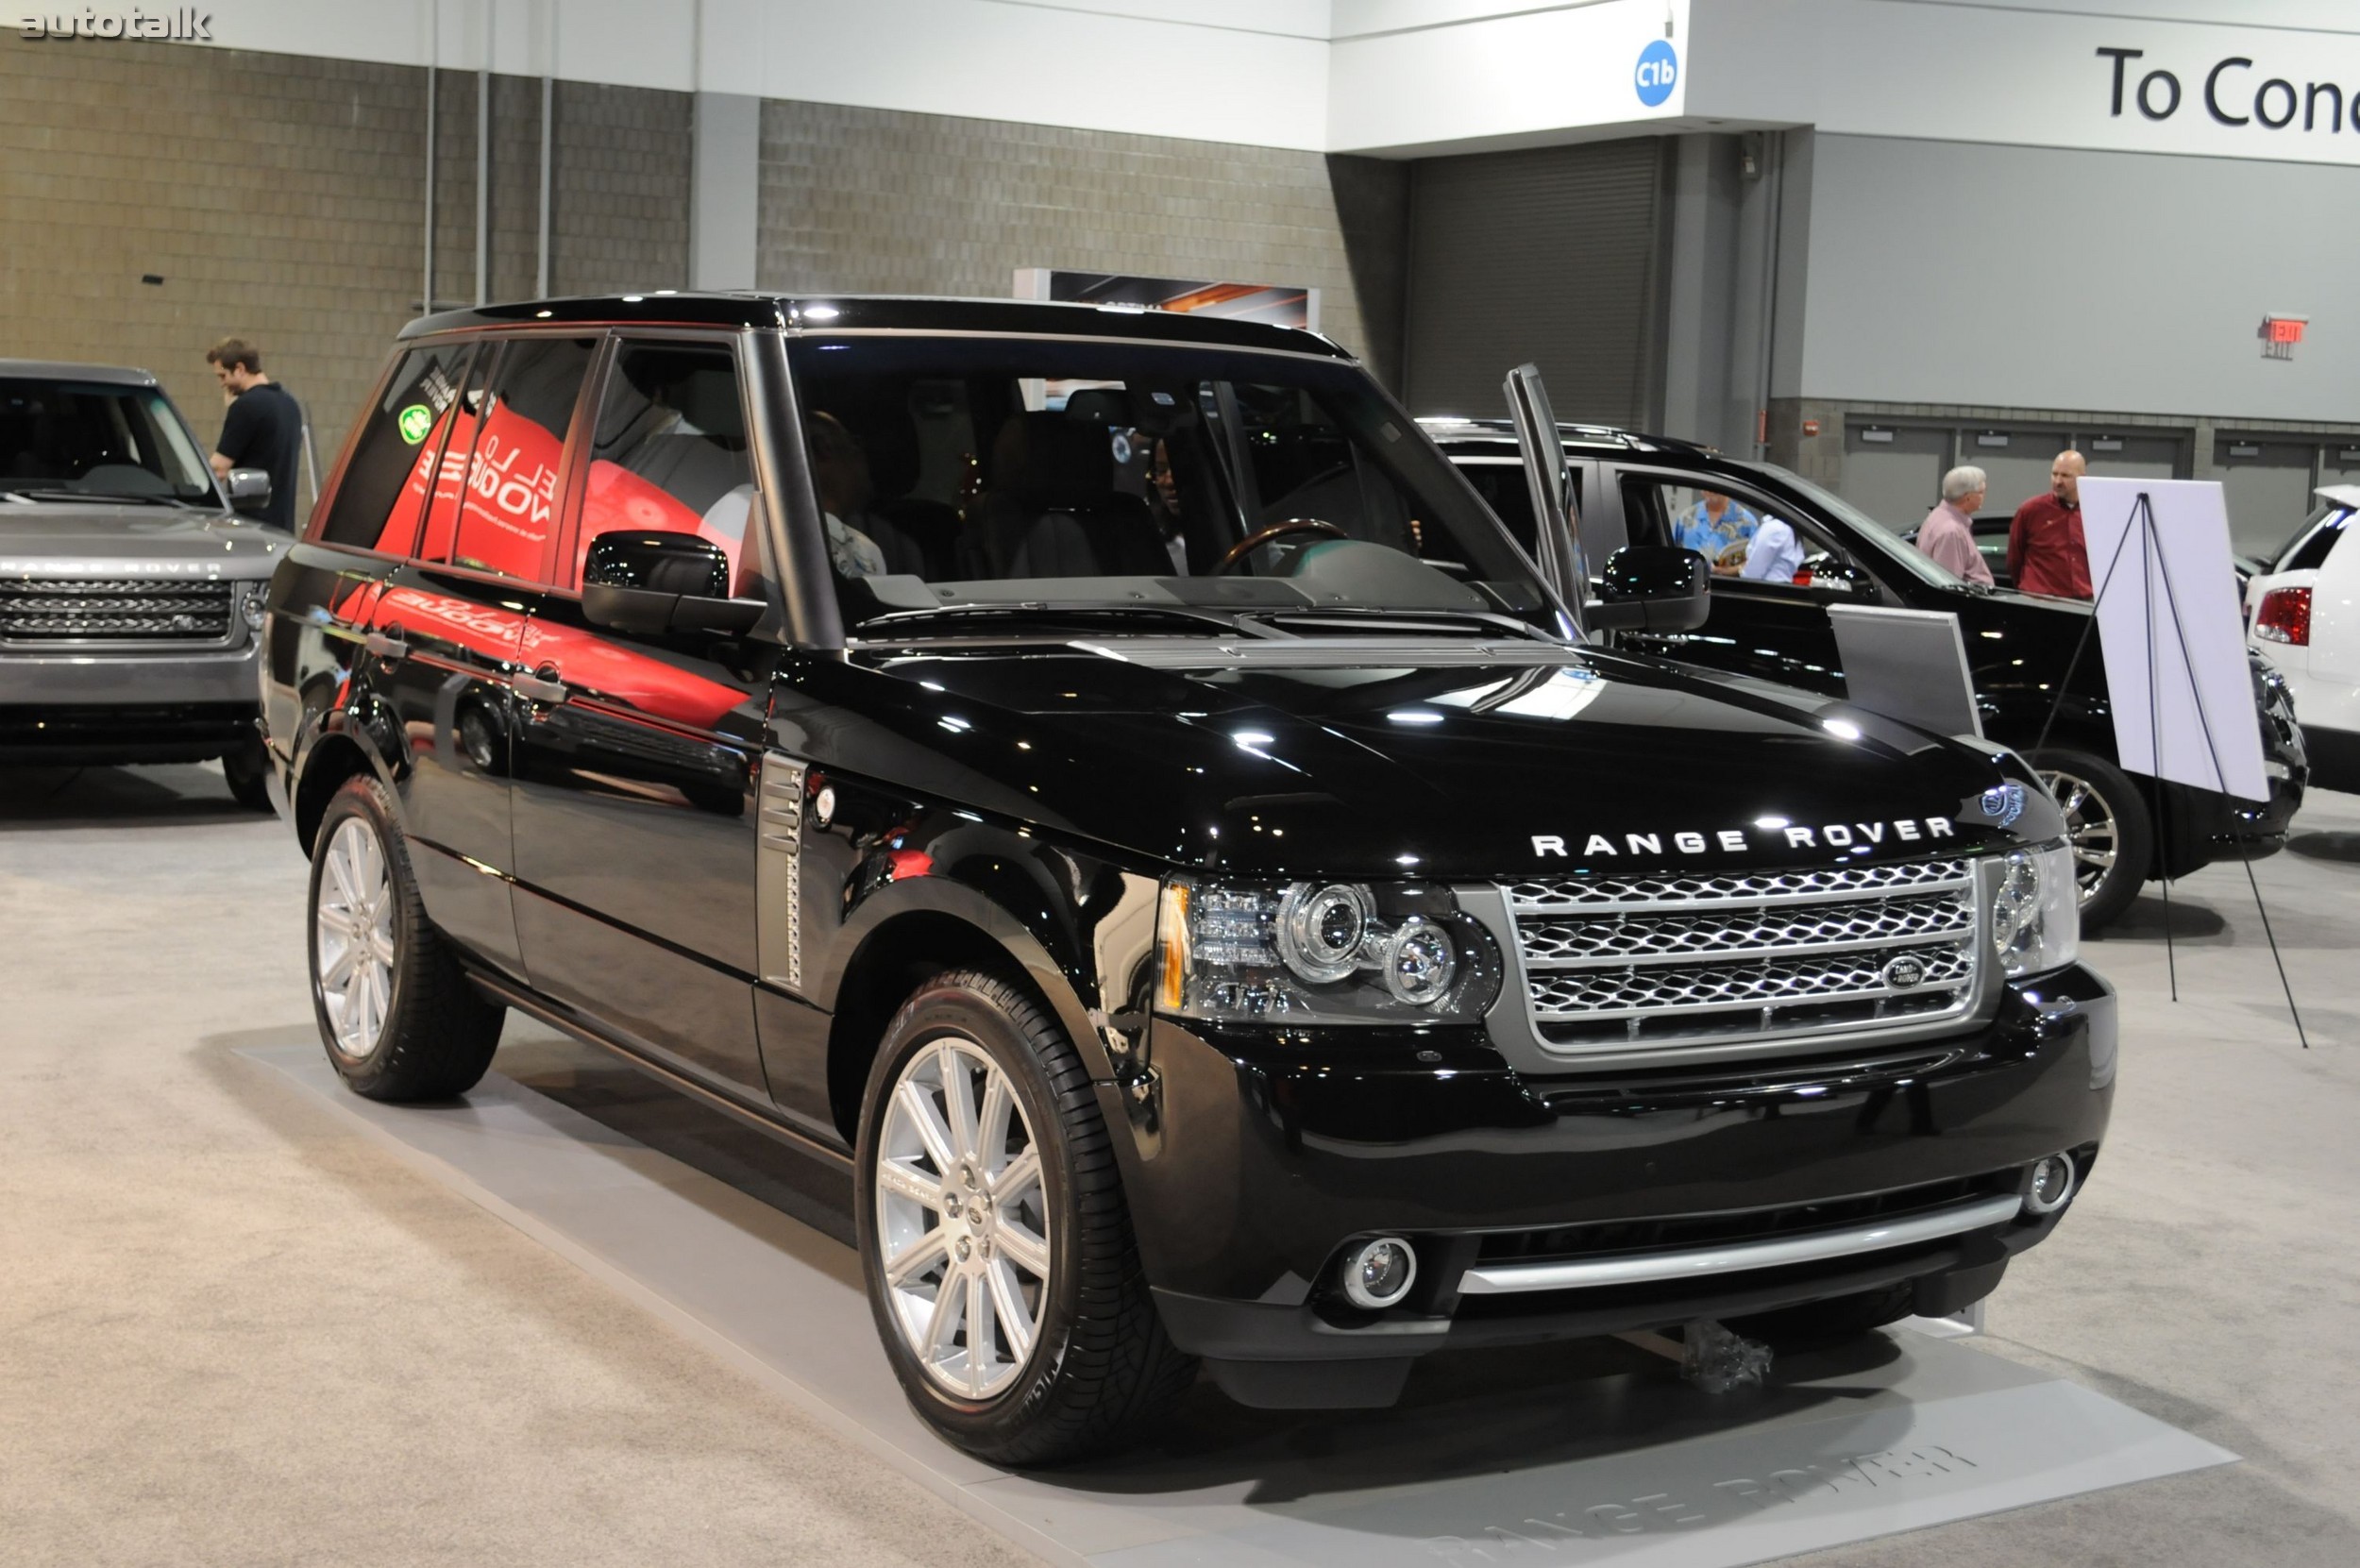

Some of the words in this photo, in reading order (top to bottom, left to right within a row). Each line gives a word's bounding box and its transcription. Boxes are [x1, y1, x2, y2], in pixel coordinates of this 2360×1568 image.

[1636, 58, 1676, 88] C1b
[2096, 46, 2182, 121] To
[2203, 57, 2360, 134] Con
[1531, 830, 1747, 858] RANGE
[1784, 817, 1954, 849] ROVER
